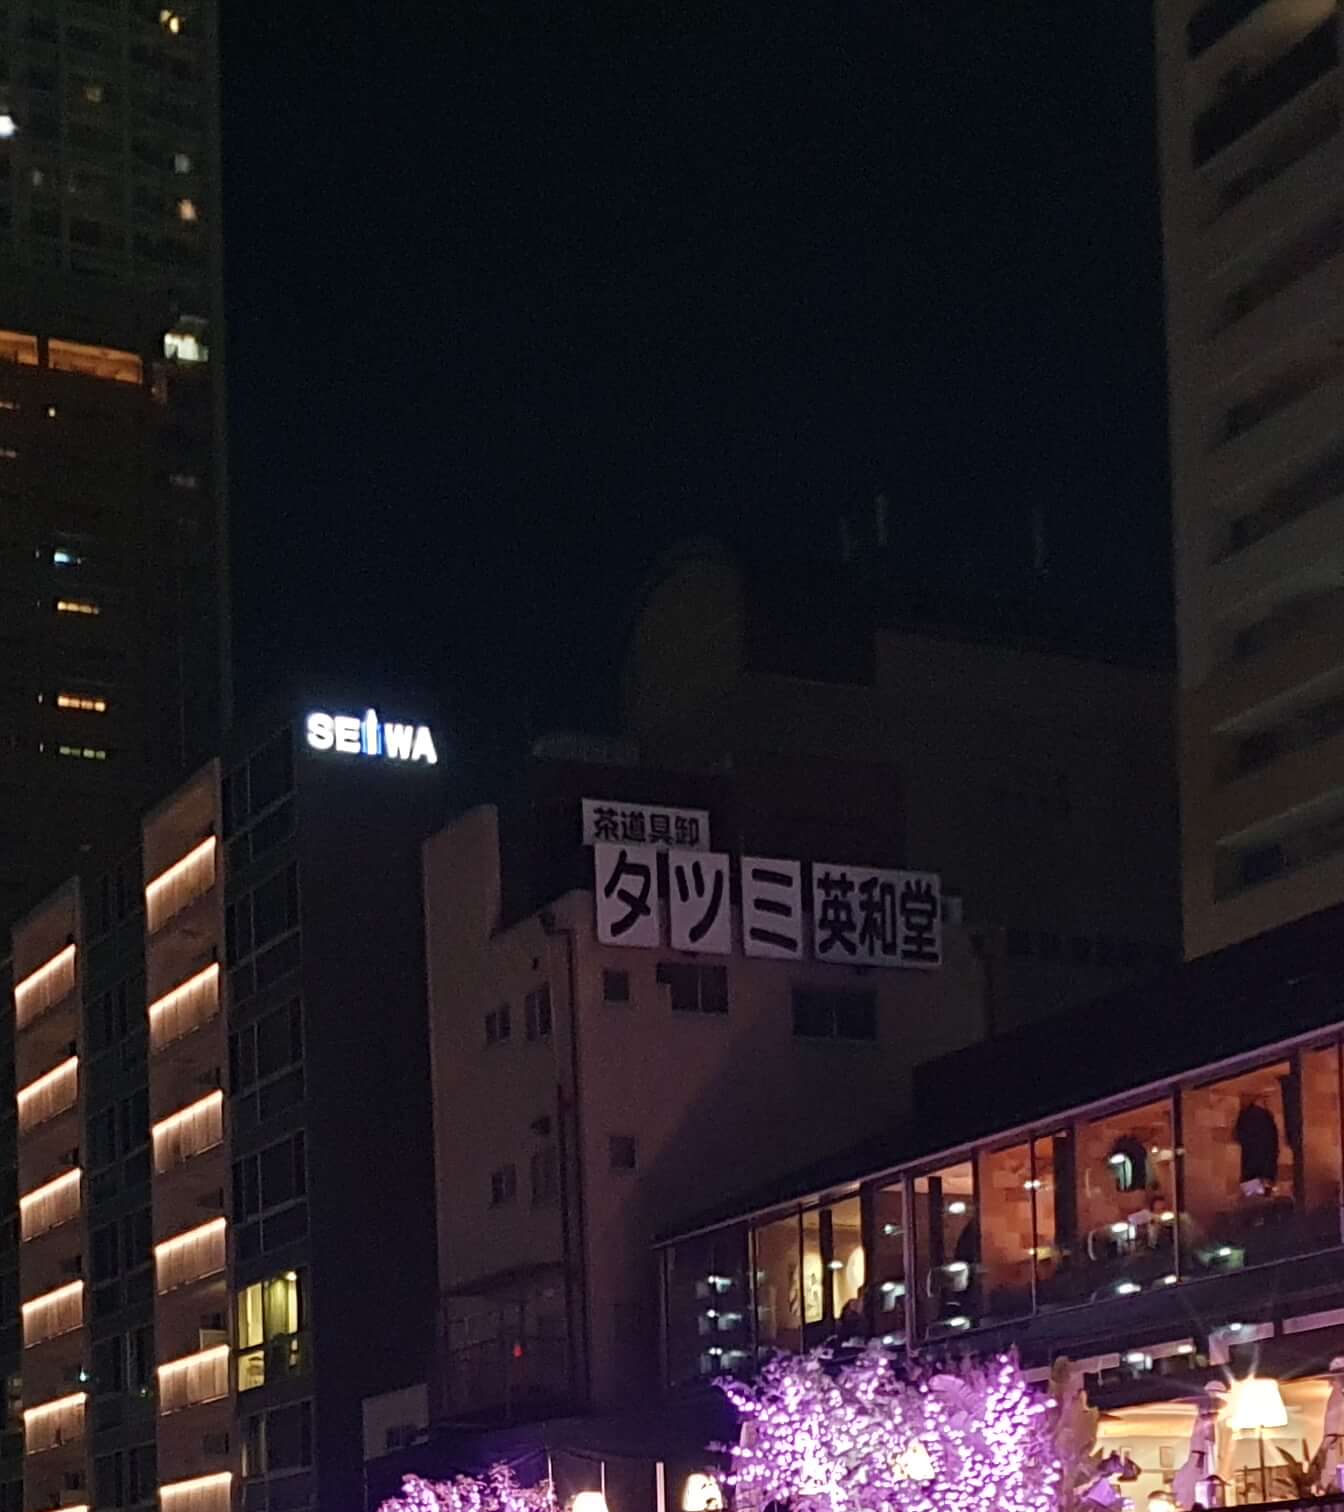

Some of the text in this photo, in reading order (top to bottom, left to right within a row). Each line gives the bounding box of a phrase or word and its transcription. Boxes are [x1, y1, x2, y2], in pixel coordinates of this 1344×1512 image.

[306, 708, 438, 764] SEIWA
[593, 808, 699, 845] 茶道具卸
